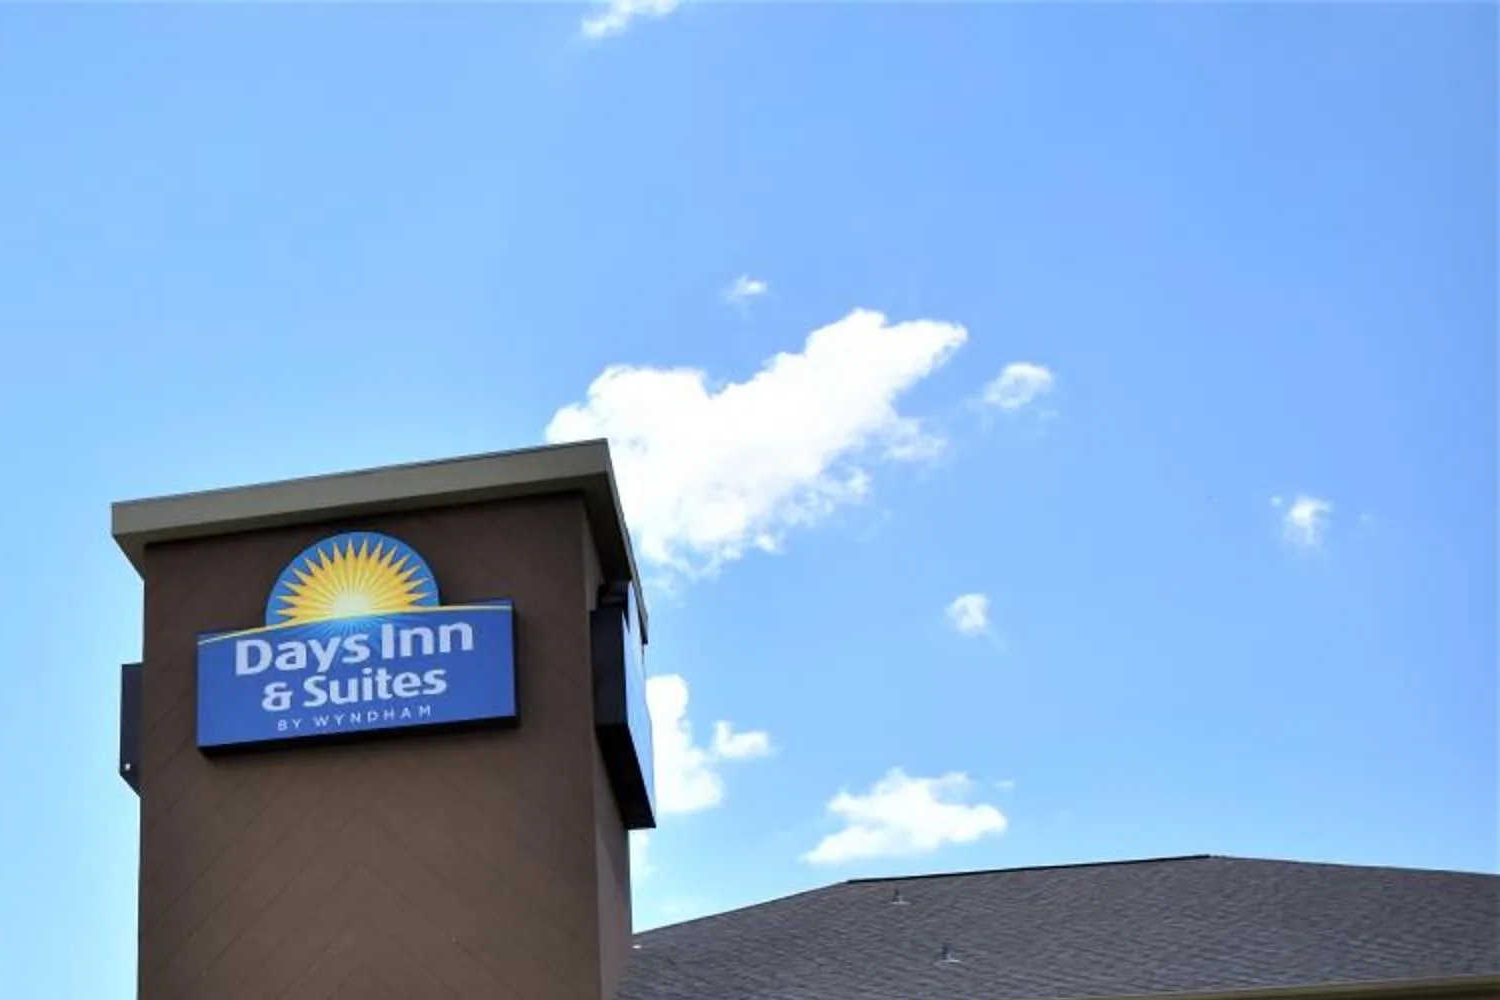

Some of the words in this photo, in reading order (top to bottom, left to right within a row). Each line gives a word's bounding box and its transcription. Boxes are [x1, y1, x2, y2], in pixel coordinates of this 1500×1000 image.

[235, 631, 371, 675] Days
[381, 620, 474, 660] Inn
[261, 682, 294, 711] &
[303, 667, 448, 707] Suites
[277, 718, 302, 732] BY
[314, 704, 433, 729] WYNDHAM
